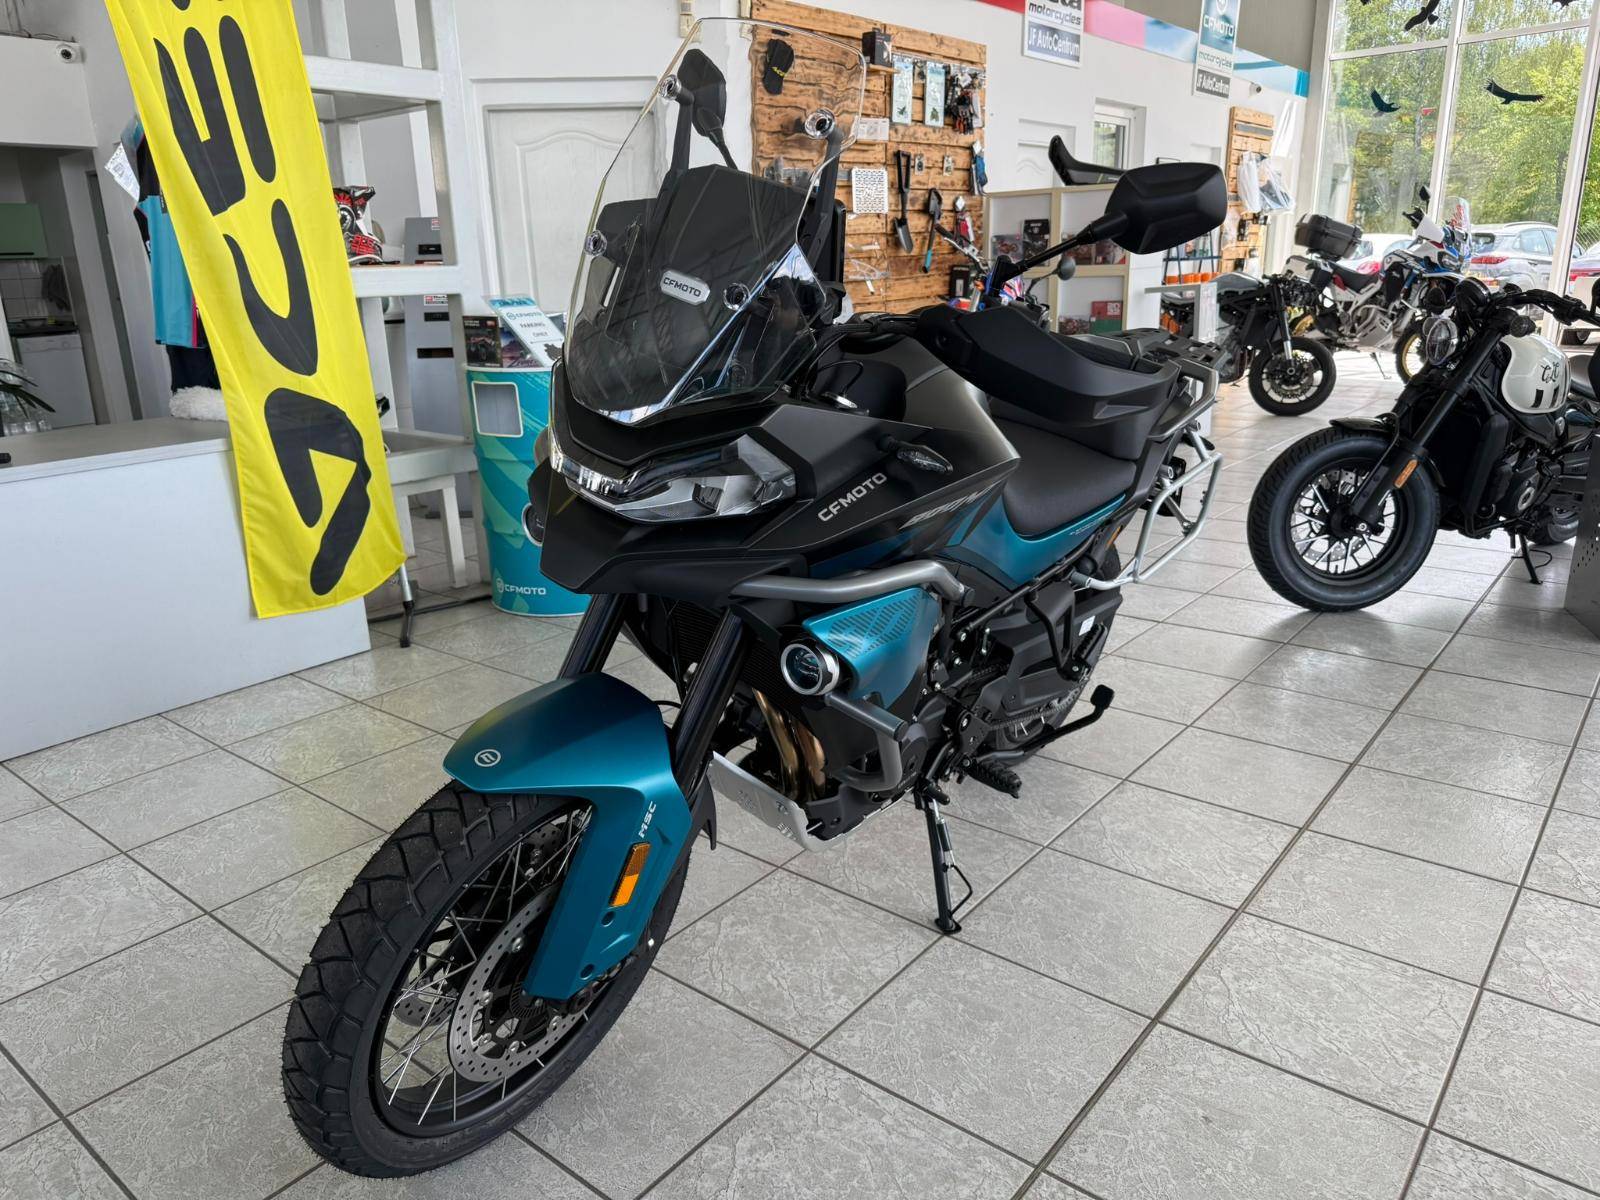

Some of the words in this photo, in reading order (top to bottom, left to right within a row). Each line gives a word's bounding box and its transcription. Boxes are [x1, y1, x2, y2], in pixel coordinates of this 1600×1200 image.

[1029, 2, 1081, 25] motorcycles
[1203, 15, 1234, 37] CFMOTO
[1028, 27, 1036, 46] JF
[1036, 30, 1080, 56] AutoCentrum
[1198, 50, 1232, 68] motorcycles
[663, 277, 702, 297] CFMOTO
[817, 472, 888, 522] CFMOTO
[504, 584, 547, 596] CFMOTO
[638, 800, 657, 839] MSC
